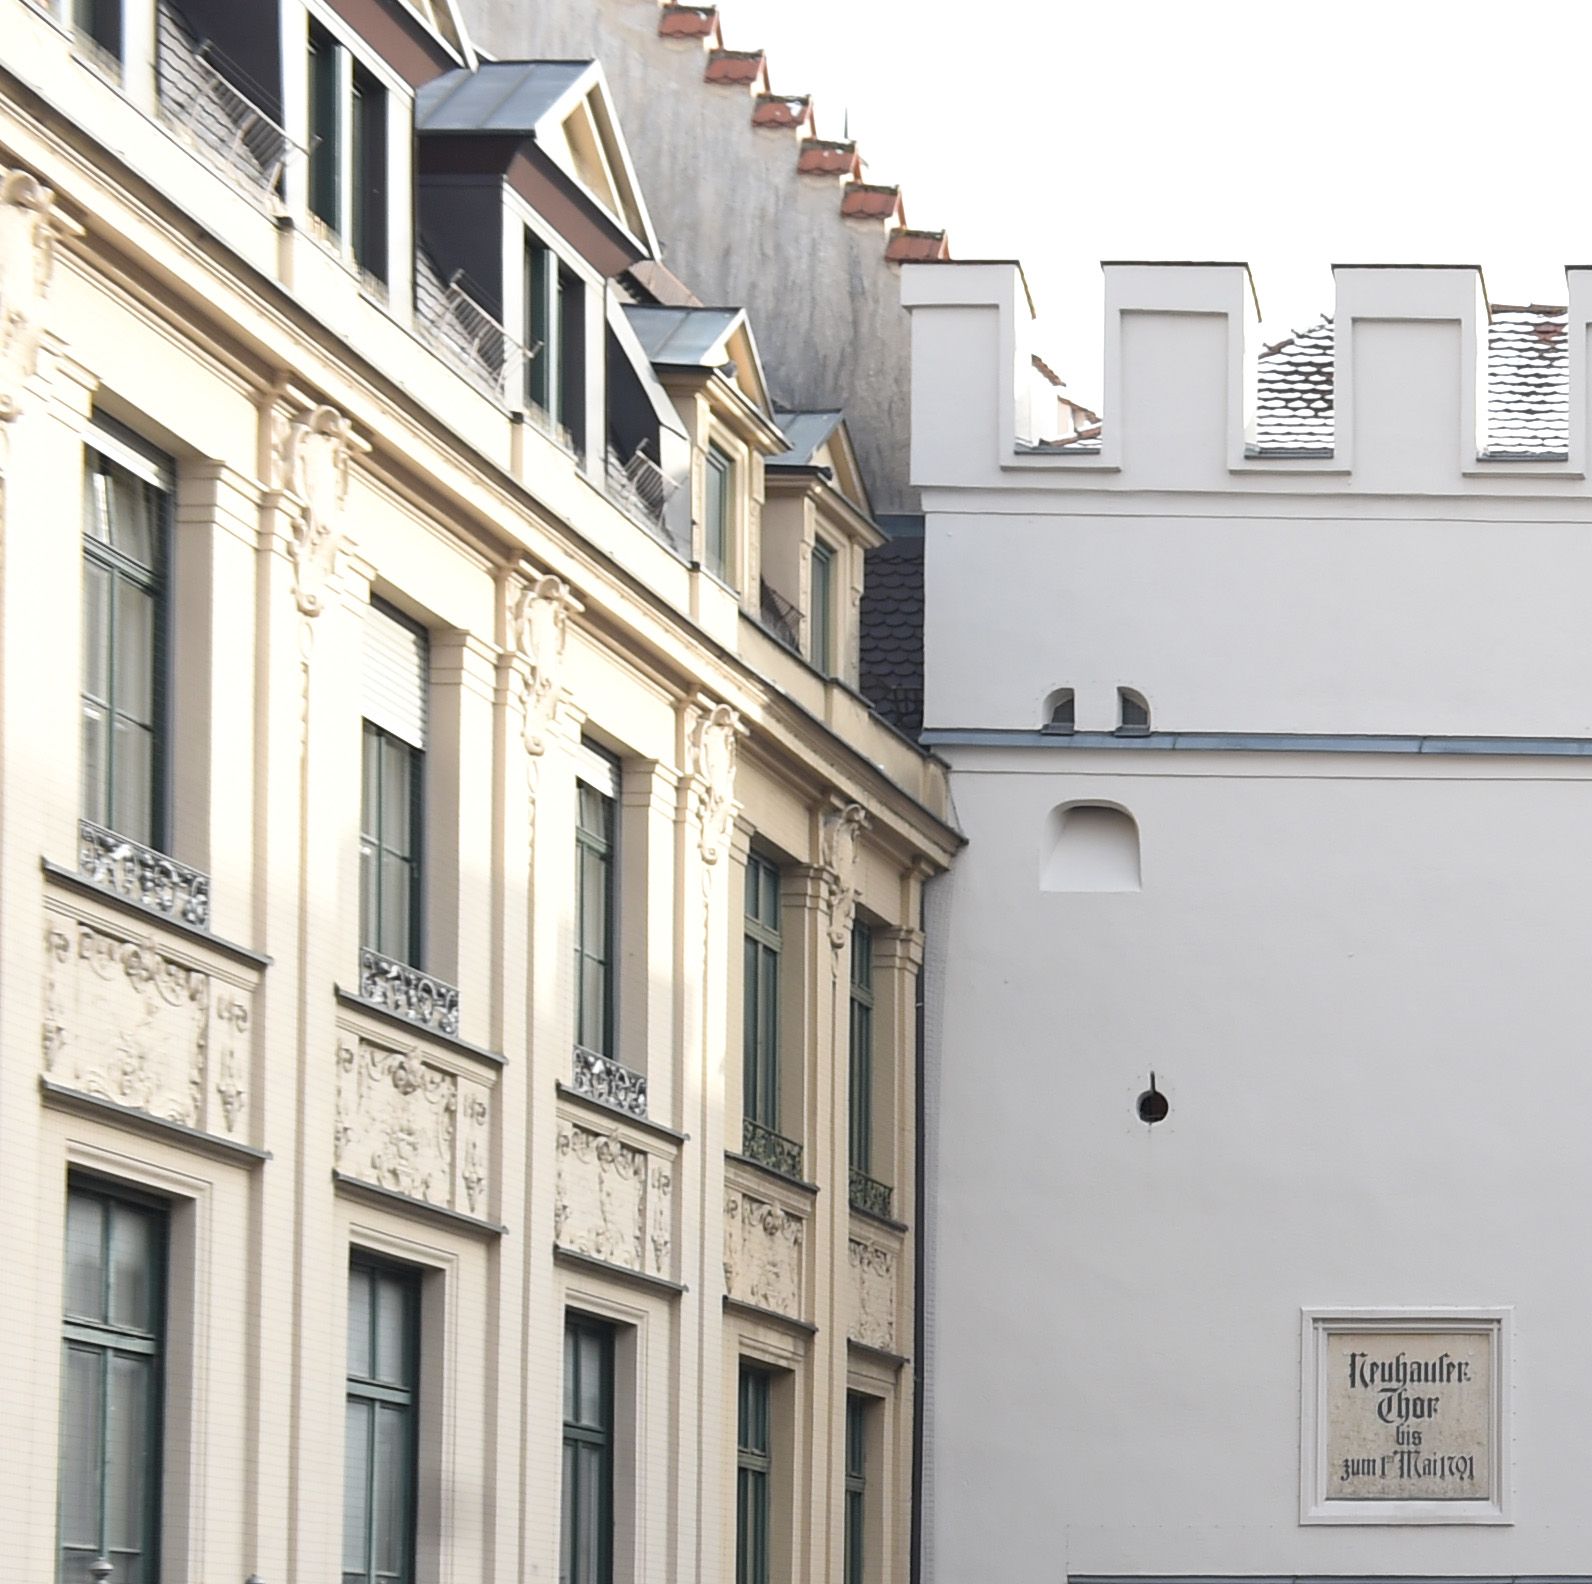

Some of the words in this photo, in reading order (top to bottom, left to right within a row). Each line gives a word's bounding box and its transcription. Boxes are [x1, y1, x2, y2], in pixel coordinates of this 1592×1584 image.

[1377, 1387, 1440, 1425] Thor
[1395, 1424, 1422, 1446] bis
[1340, 1456, 1376, 1481] zum
[1393, 1450, 1437, 1479] Mai
[1440, 1455, 1474, 1481] 1791
